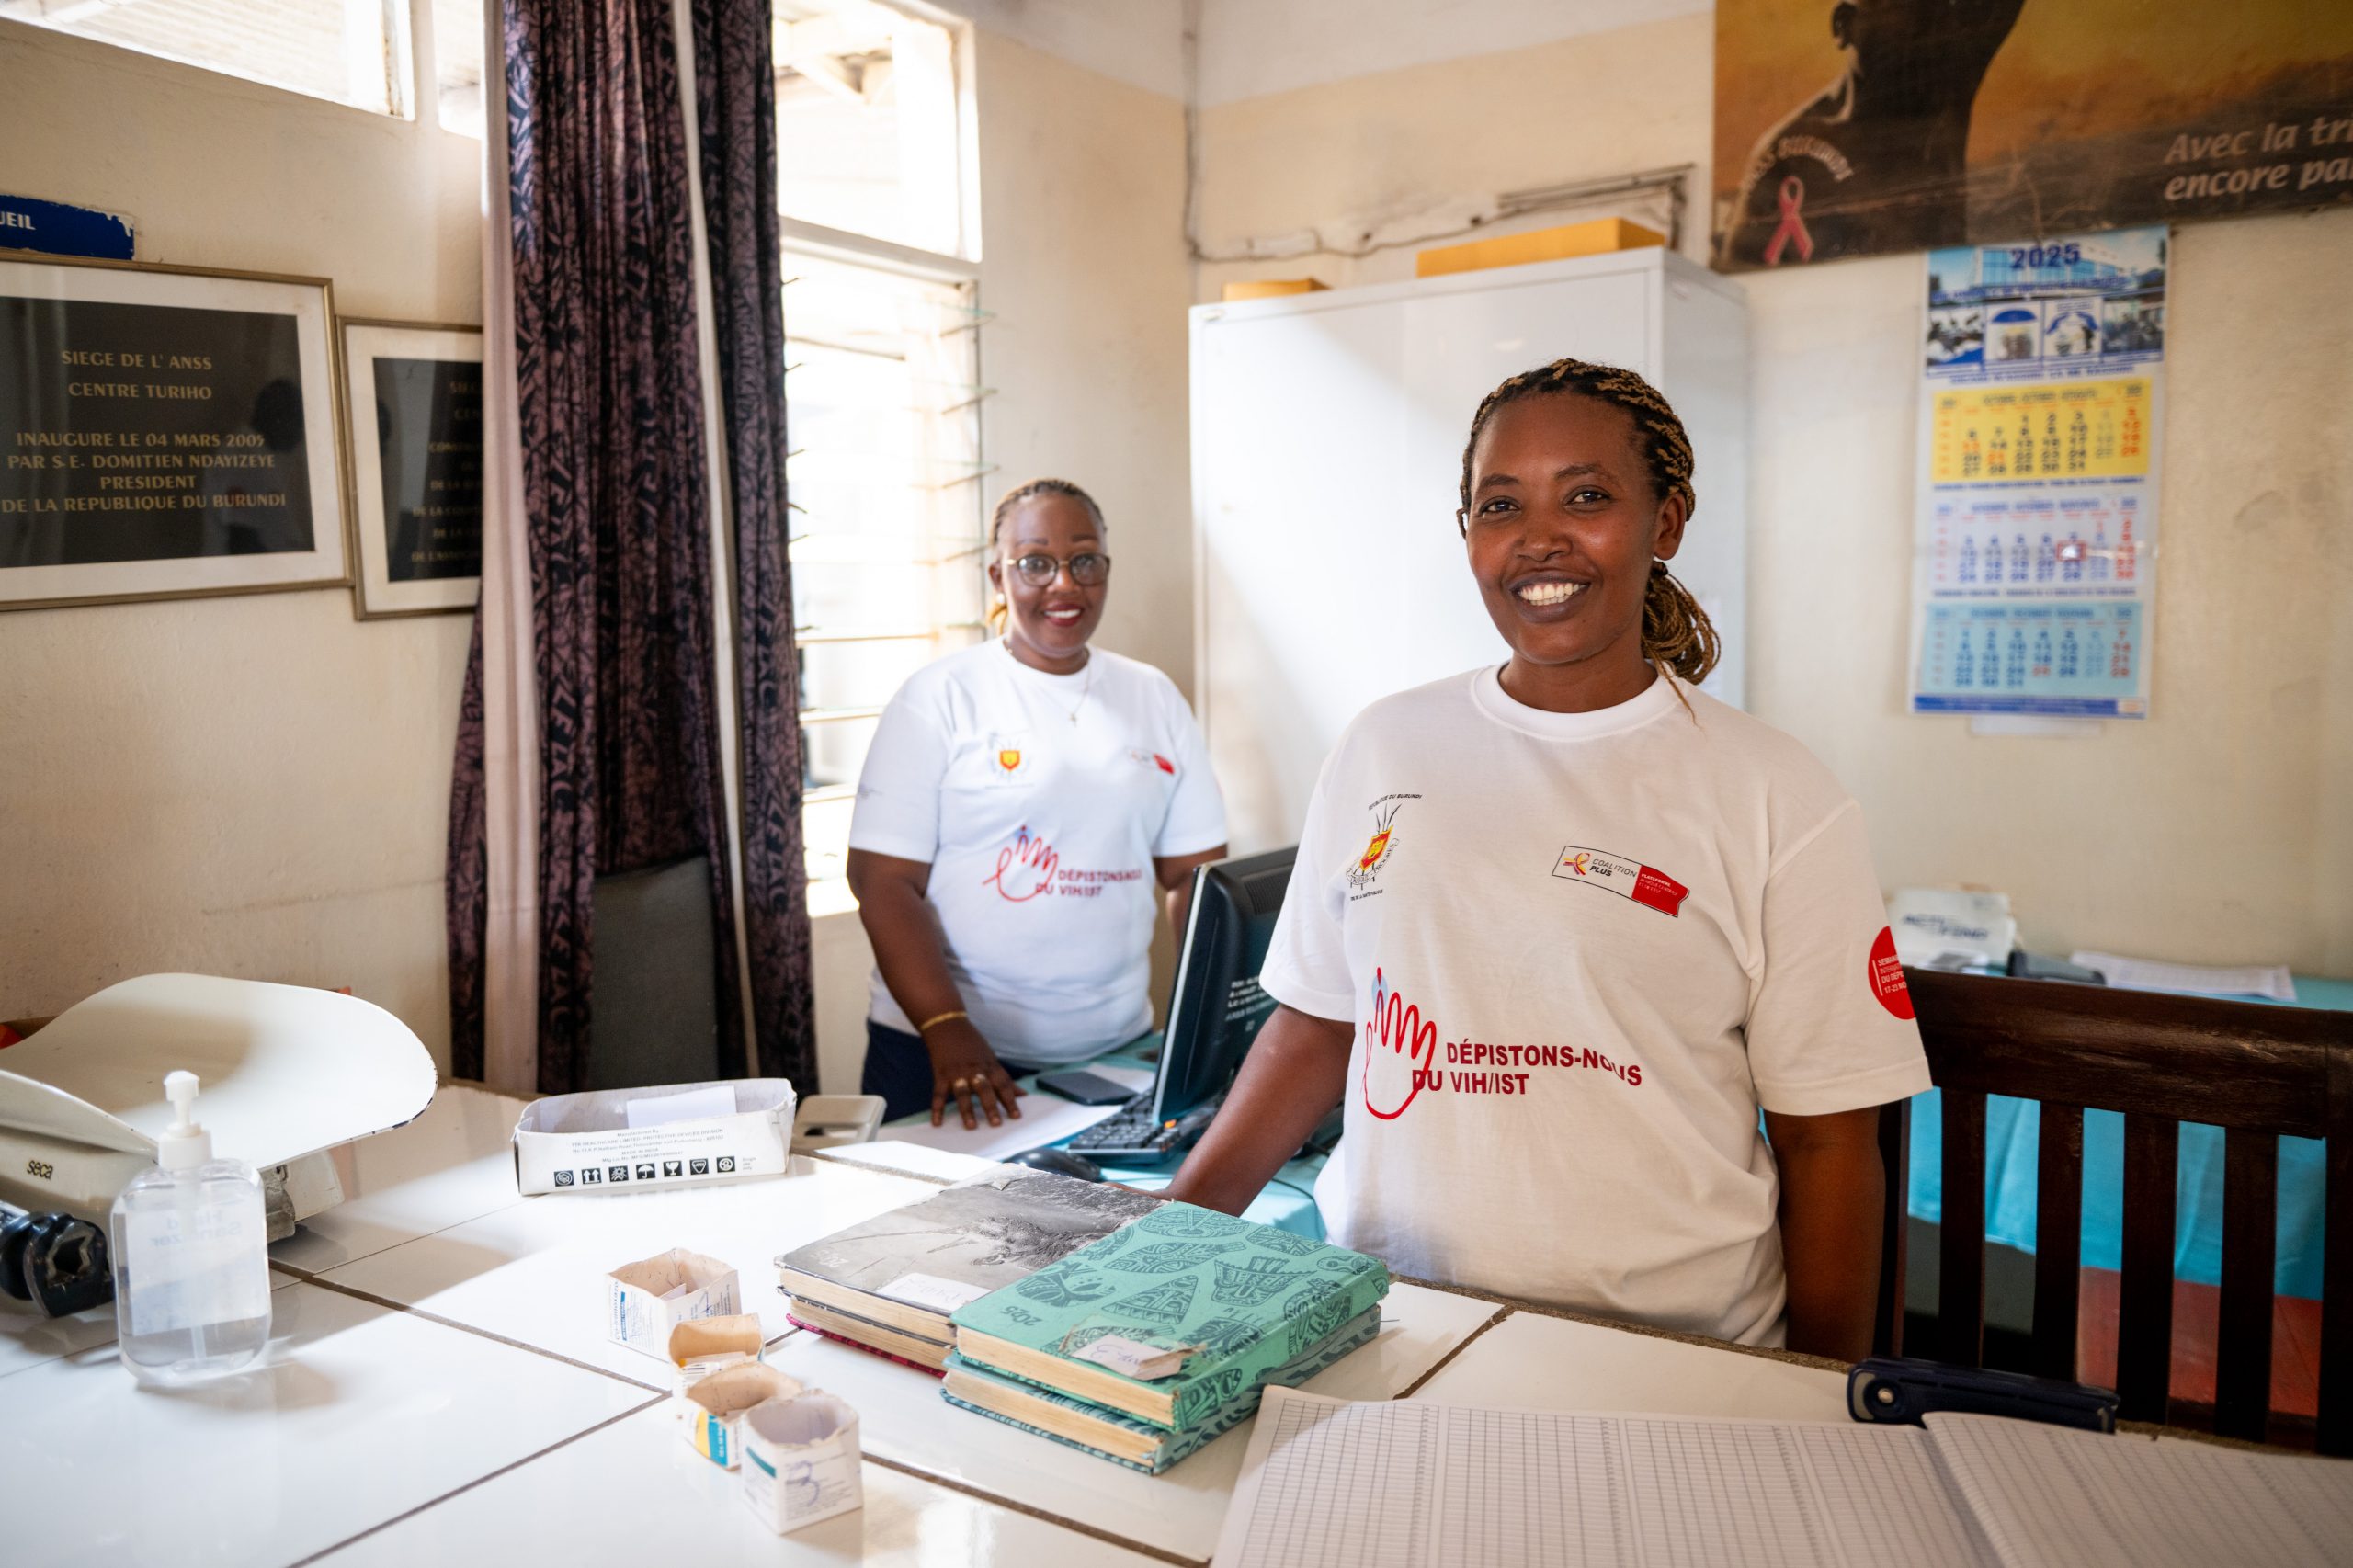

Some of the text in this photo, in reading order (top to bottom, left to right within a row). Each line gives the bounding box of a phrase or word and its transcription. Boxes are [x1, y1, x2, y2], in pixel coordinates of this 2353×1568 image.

[2164, 131, 2252, 164] Avec
[2261, 123, 2299, 153] la
[2165, 164, 2290, 201] encore
[2011, 244, 2081, 269] 2025
[61, 350, 115, 366] SIEGE
[121, 354, 144, 368] DE
[169, 356, 212, 369] ANSS
[68, 382, 212, 399] CENTRE TURIHO
[17, 433, 265, 448] INAUGURE LE 04 MARS 2005
[7, 455, 45, 469] PAR
[92, 455, 184, 469] DOMITIEN
[189, 455, 276, 468] NDAYIZEYE
[100, 476, 196, 489] PRESIDENT
[2, 494, 286, 513] DE LA REPUBLIQUE DU BURUNDI
[1589, 865, 1613, 877] PLUS
[1592, 858, 1637, 878] COALITION
[1447, 1039, 1643, 1086] DÉPISTONS-NOUS
[1412, 1069, 1529, 1095] DU VIH/IST
[26, 1159, 54, 1180] seca
[1000, 1306, 1043, 1326] 2025
